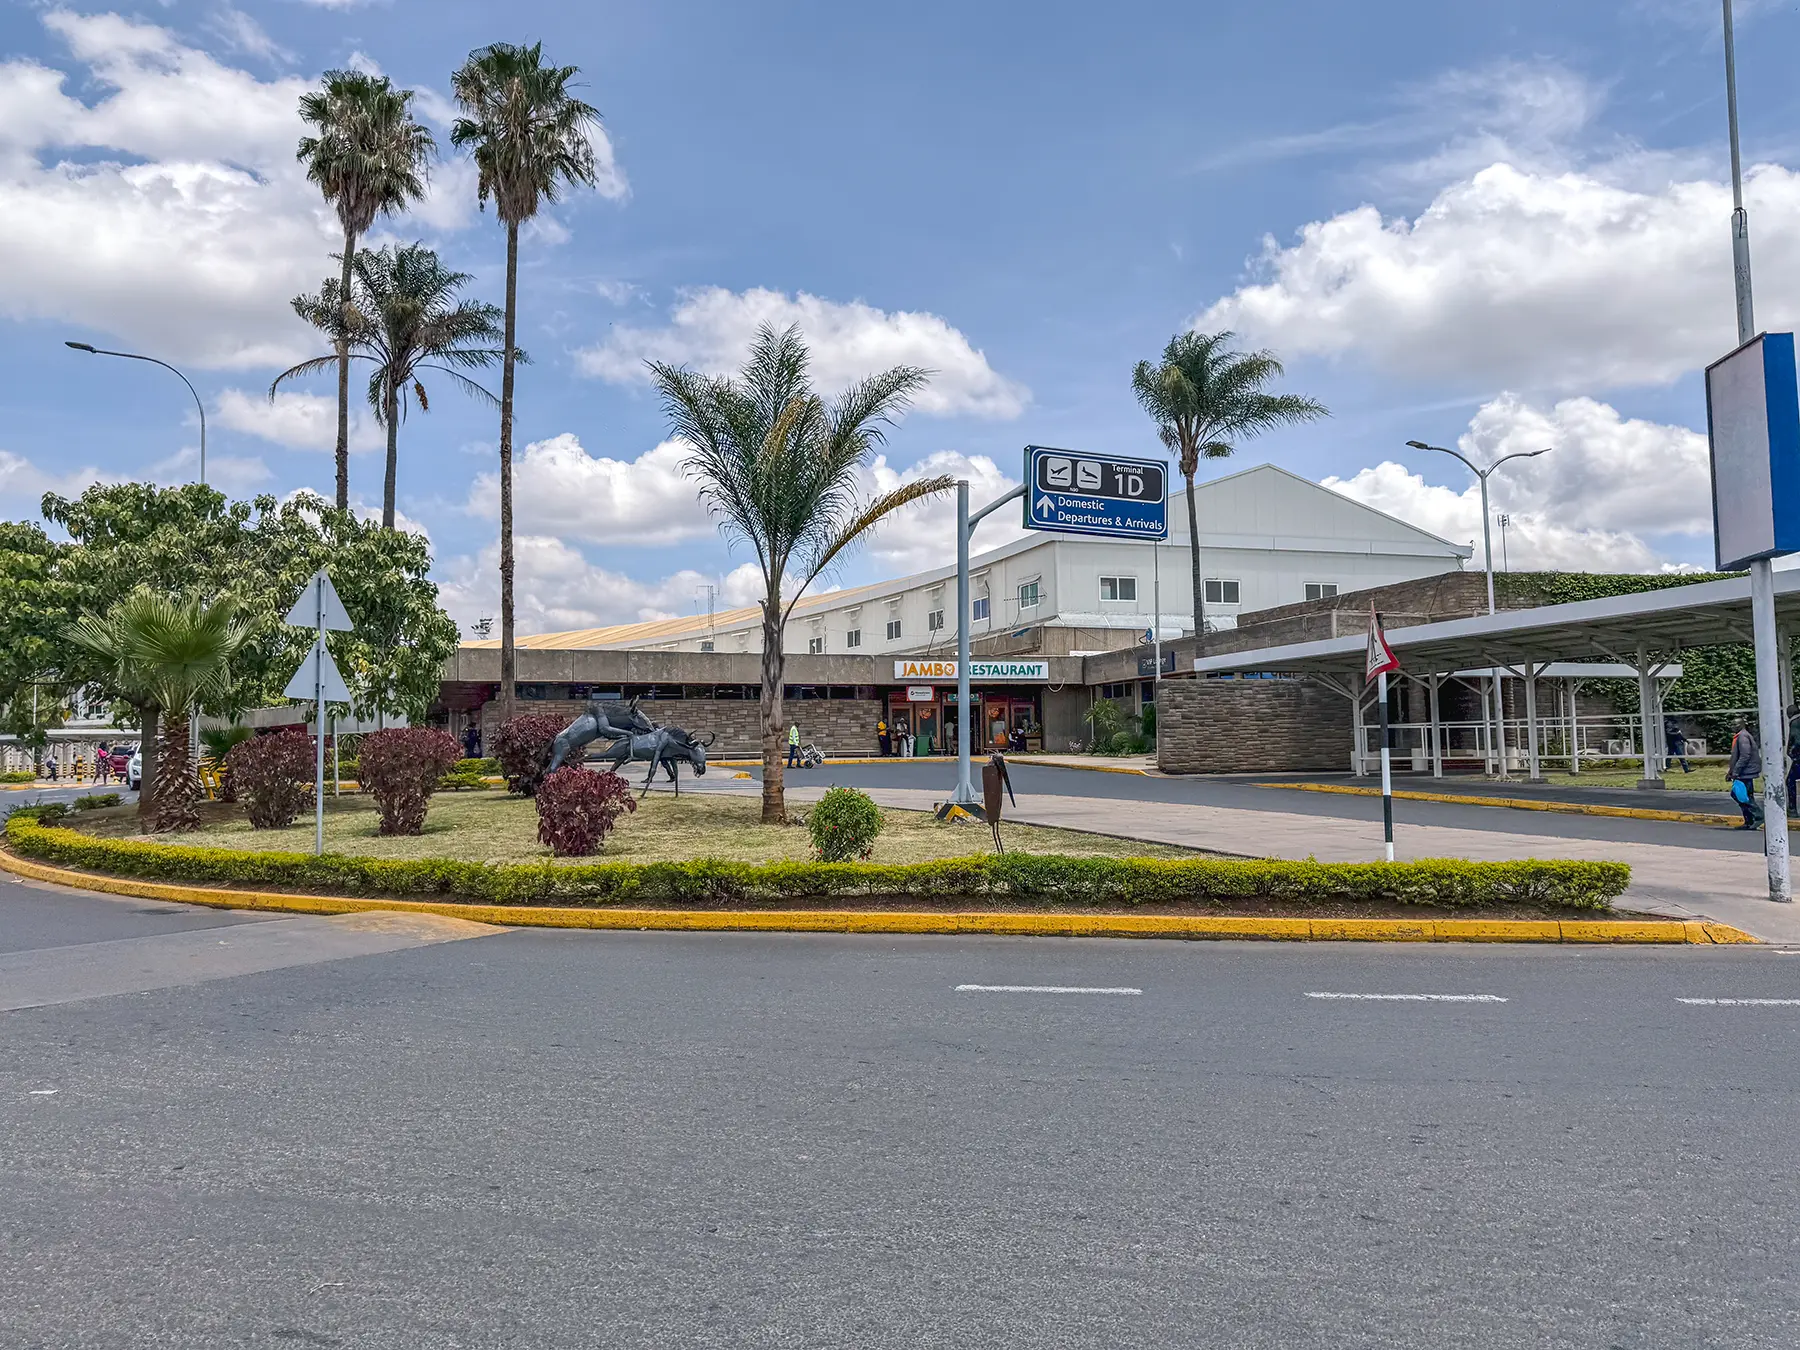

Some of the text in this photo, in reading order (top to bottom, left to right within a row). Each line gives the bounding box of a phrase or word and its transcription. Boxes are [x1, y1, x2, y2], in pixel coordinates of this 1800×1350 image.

[1112, 464, 1144, 475] Terminal
[1114, 474, 1144, 496] 1D
[1058, 497, 1104, 510] Domestic
[1058, 511, 1163, 530] Departures & Arrivals
[902, 662, 1042, 677] JAMBO ESTAURANT
